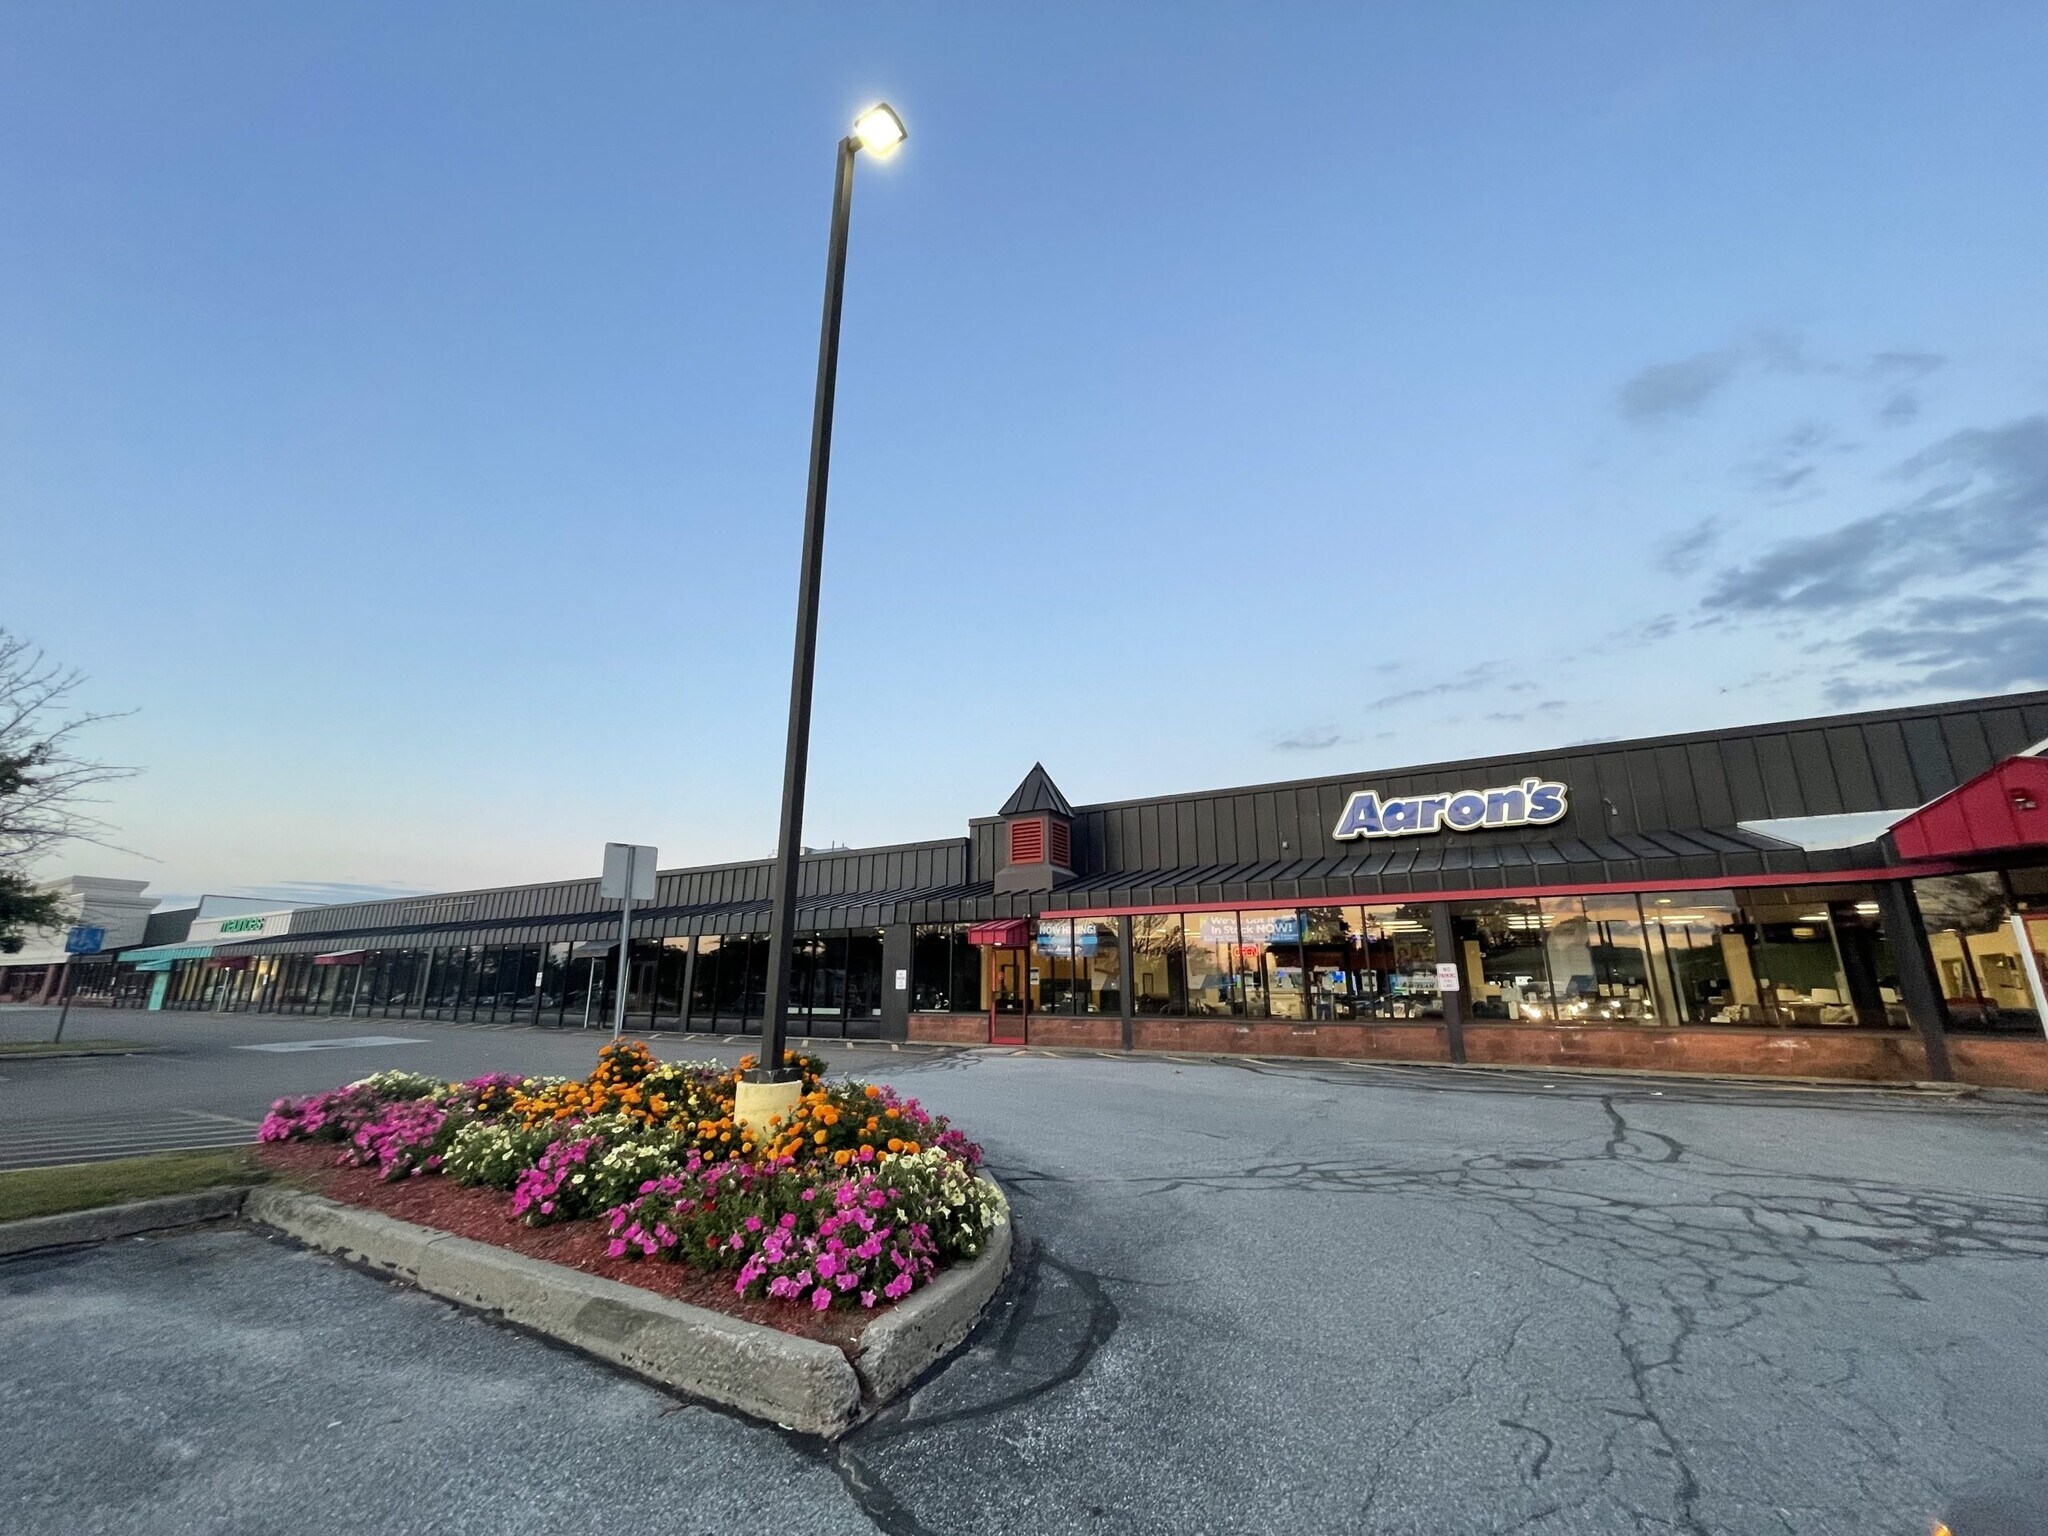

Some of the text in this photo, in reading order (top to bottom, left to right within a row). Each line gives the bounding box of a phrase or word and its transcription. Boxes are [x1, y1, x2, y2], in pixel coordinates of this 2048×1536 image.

[1335, 779, 1567, 838] Aaron's
[1210, 916, 1244, 924] We'v
[1039, 925, 1061, 935] NOW
[1211, 926, 1221, 934] In
[1256, 923, 1293, 934] NOW!
[1233, 946, 1260, 957] OPEN
